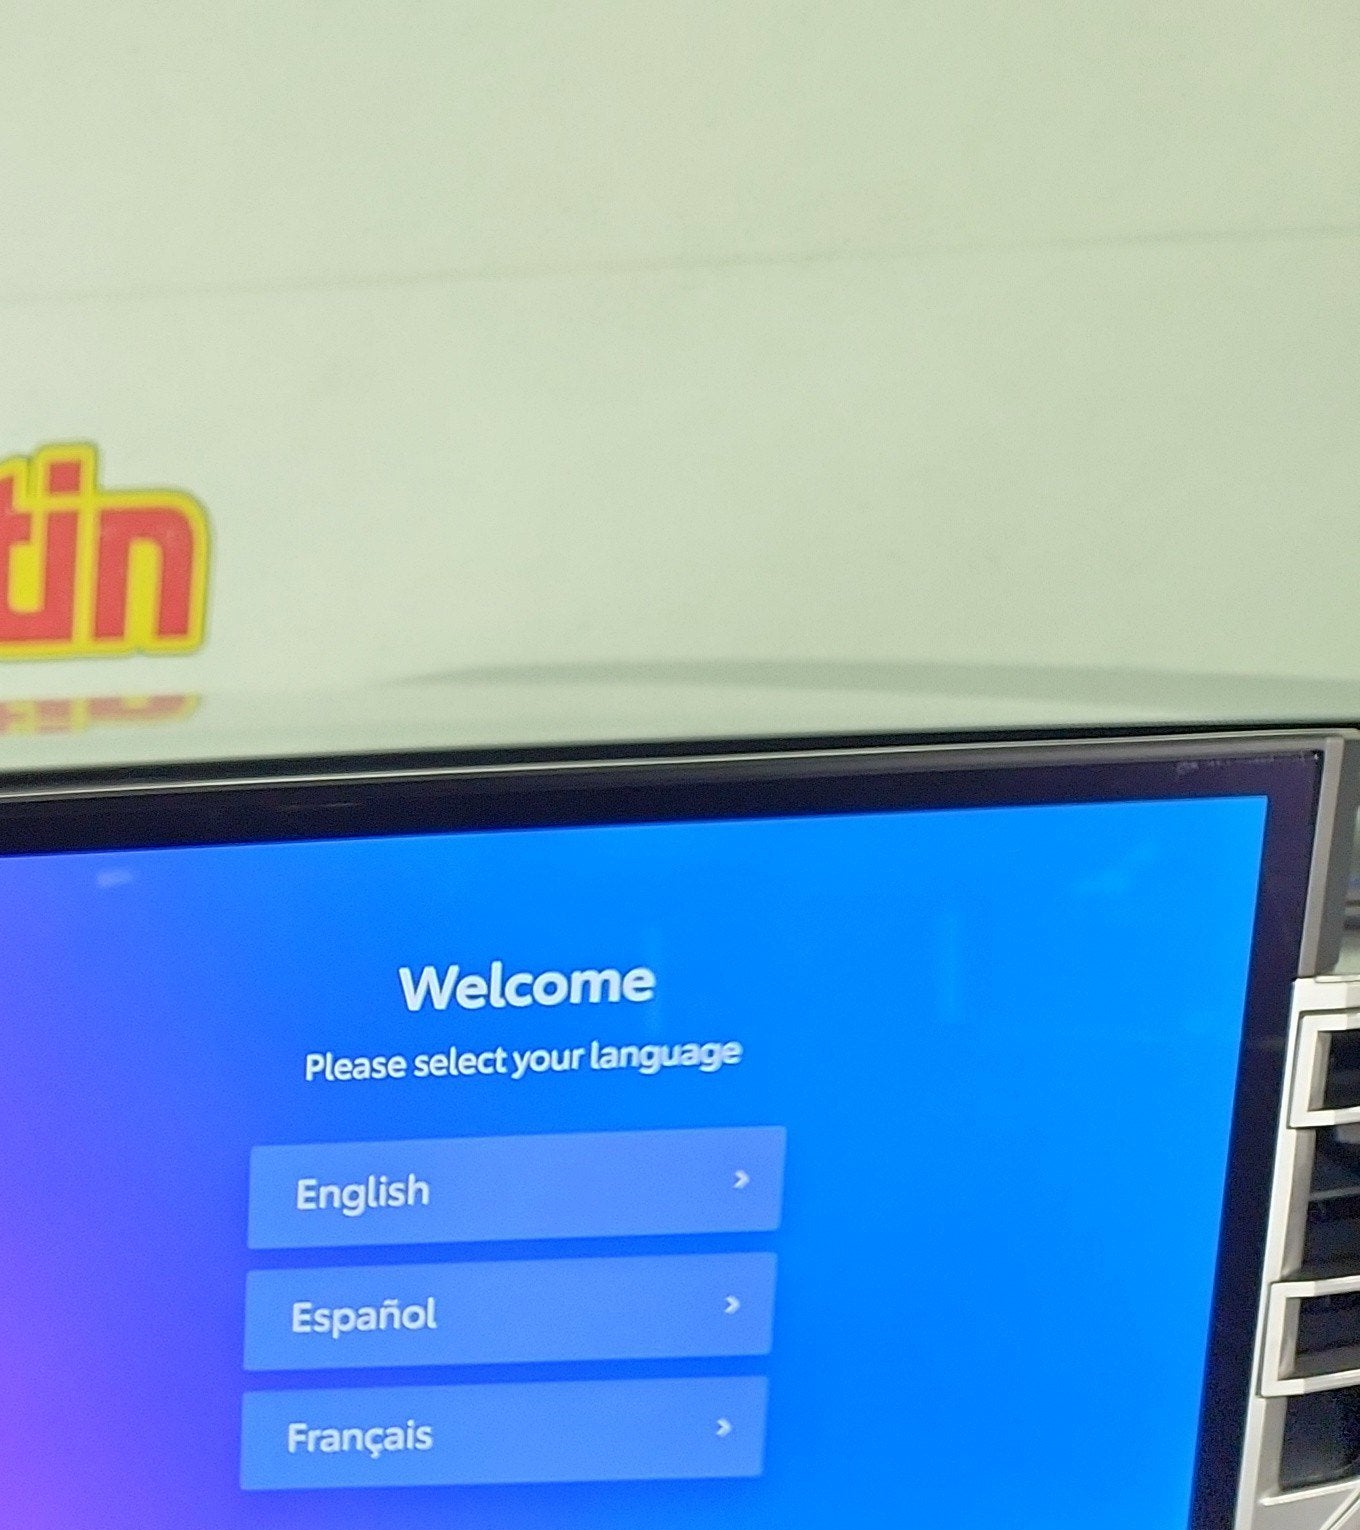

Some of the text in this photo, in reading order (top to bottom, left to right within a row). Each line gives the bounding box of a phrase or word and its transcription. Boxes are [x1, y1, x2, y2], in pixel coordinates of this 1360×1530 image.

[399, 960, 656, 1012] Welcome
[305, 1039, 743, 1081] Please select your language
[296, 1173, 430, 1217] English
[291, 1296, 437, 1339] Español
[287, 1419, 433, 1459] Français
